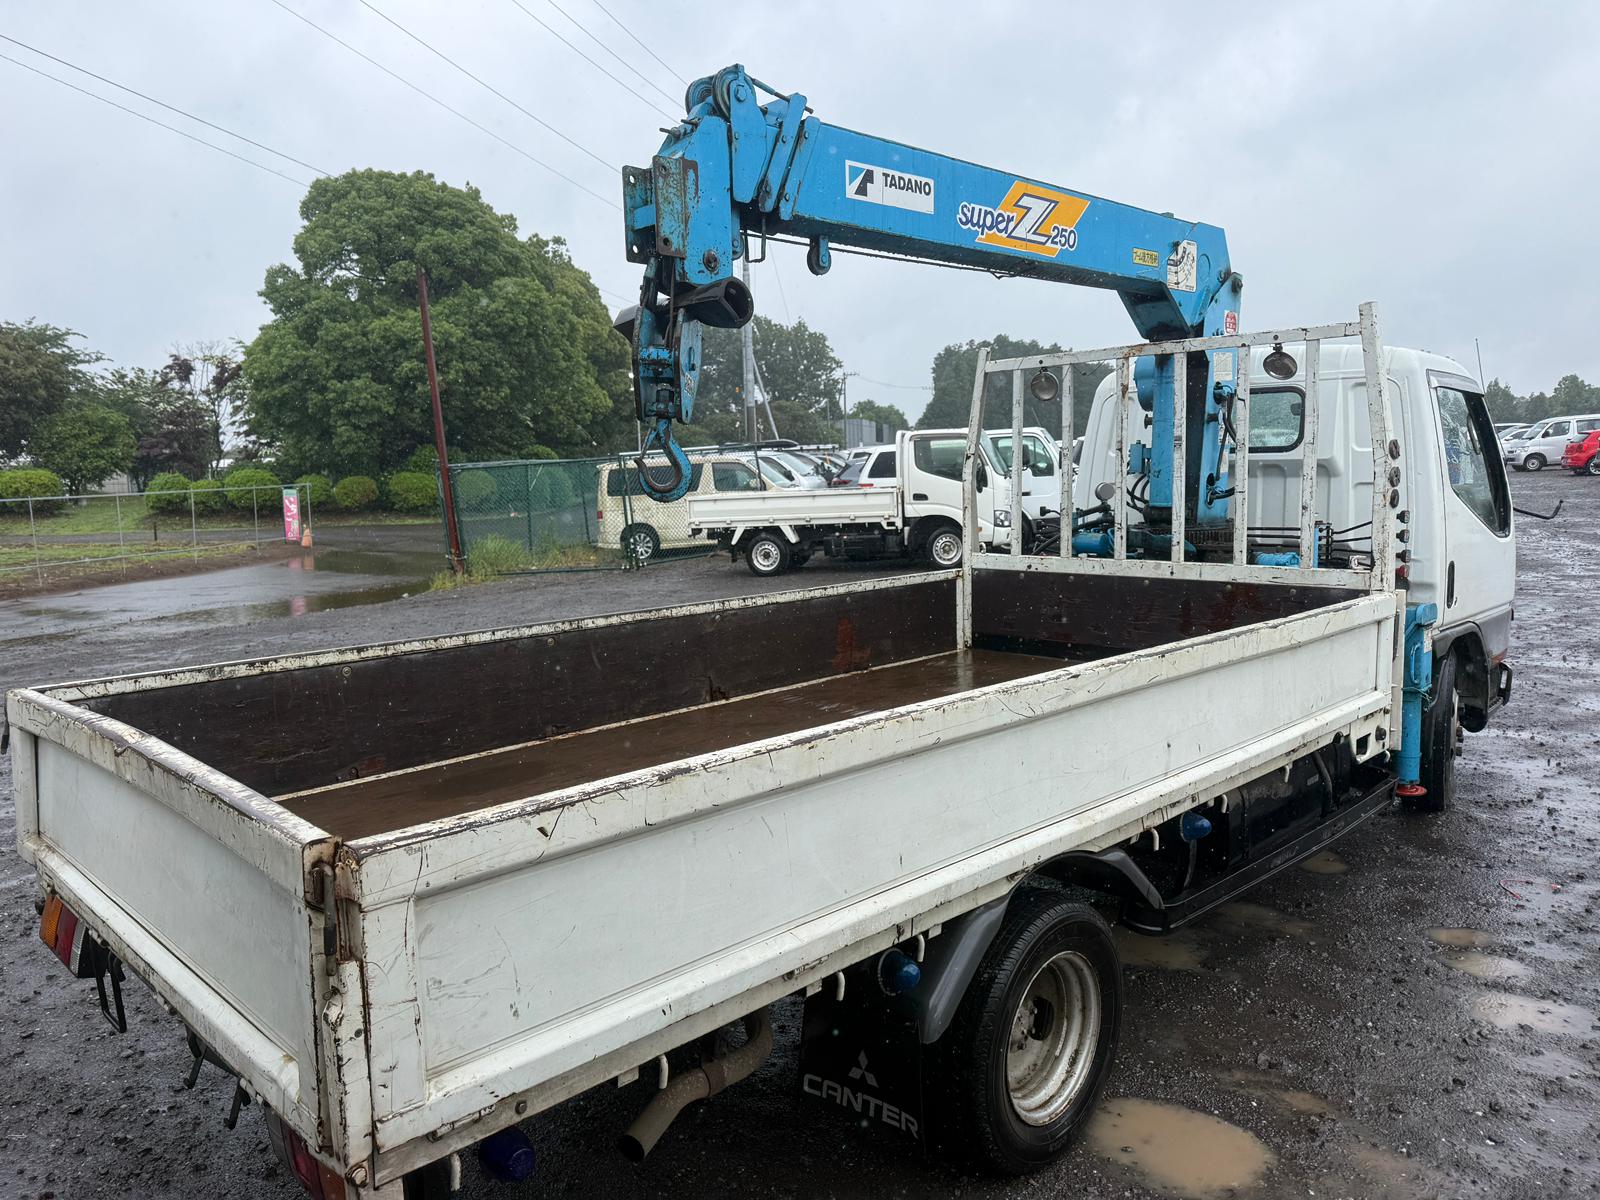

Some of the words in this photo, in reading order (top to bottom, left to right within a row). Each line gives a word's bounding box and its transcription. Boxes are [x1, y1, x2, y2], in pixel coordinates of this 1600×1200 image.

[882, 172, 932, 197] TADANO
[958, 203, 1015, 236] super
[1050, 225, 1077, 250] 250
[803, 1073, 919, 1140] CANTER
